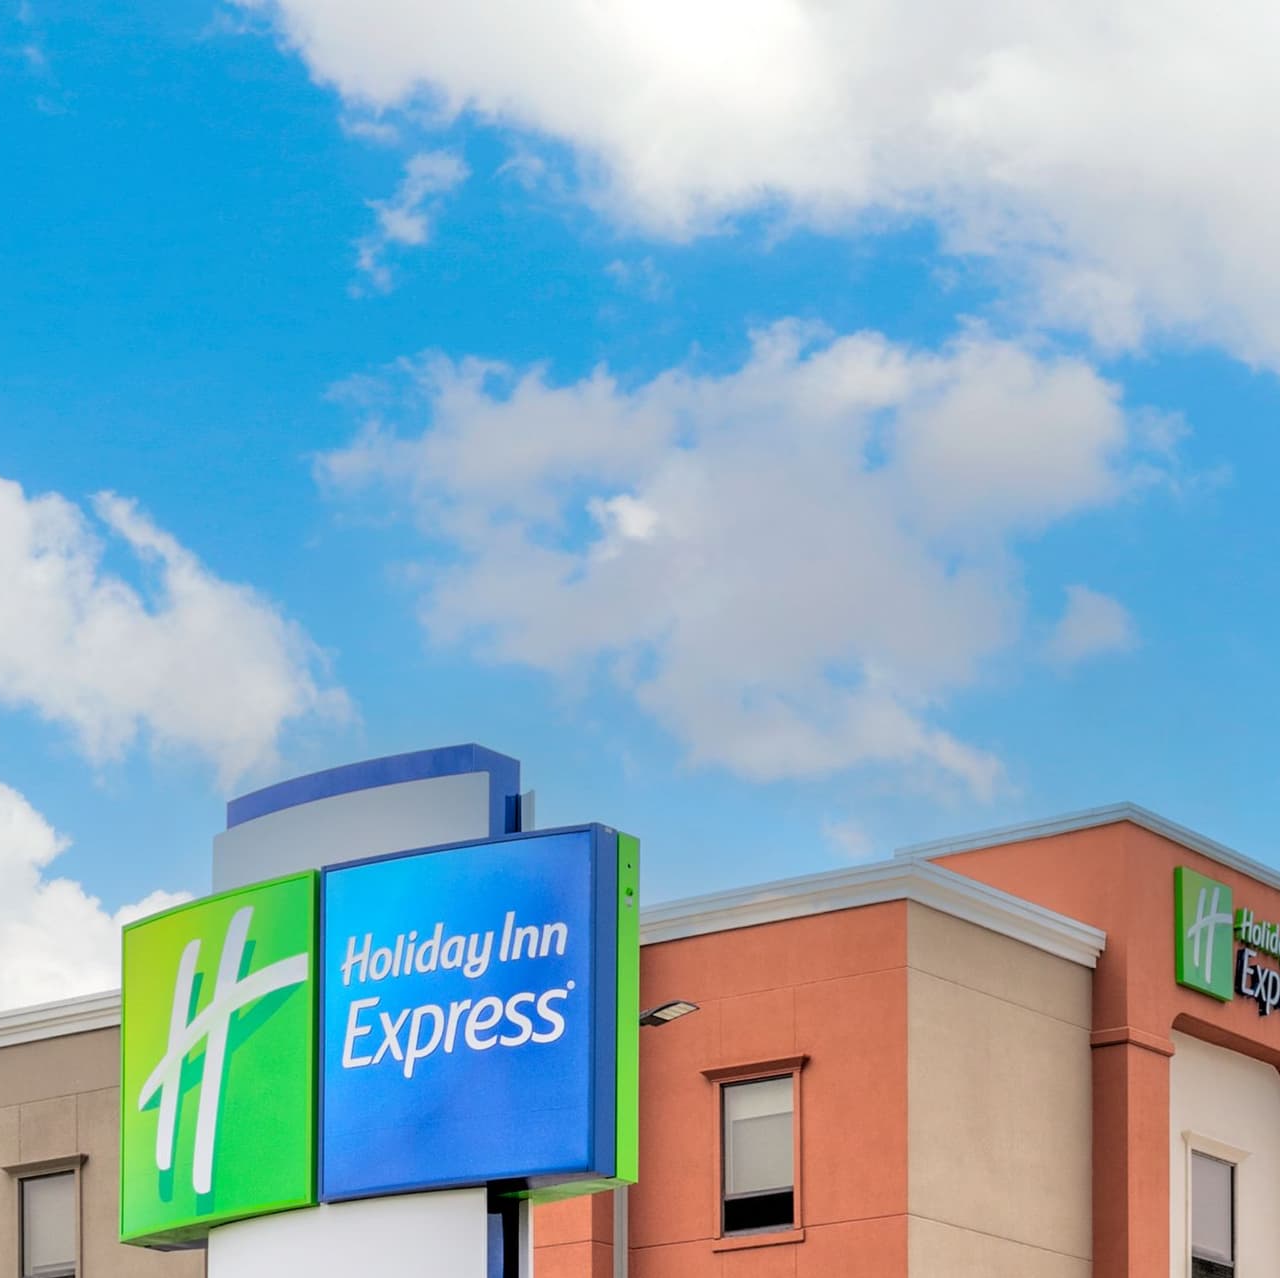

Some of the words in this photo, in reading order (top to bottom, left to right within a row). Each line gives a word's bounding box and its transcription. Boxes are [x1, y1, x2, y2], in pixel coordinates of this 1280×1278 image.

[340, 923, 491, 986] Holiday
[499, 911, 568, 961] Inn
[341, 987, 569, 1079] Express
